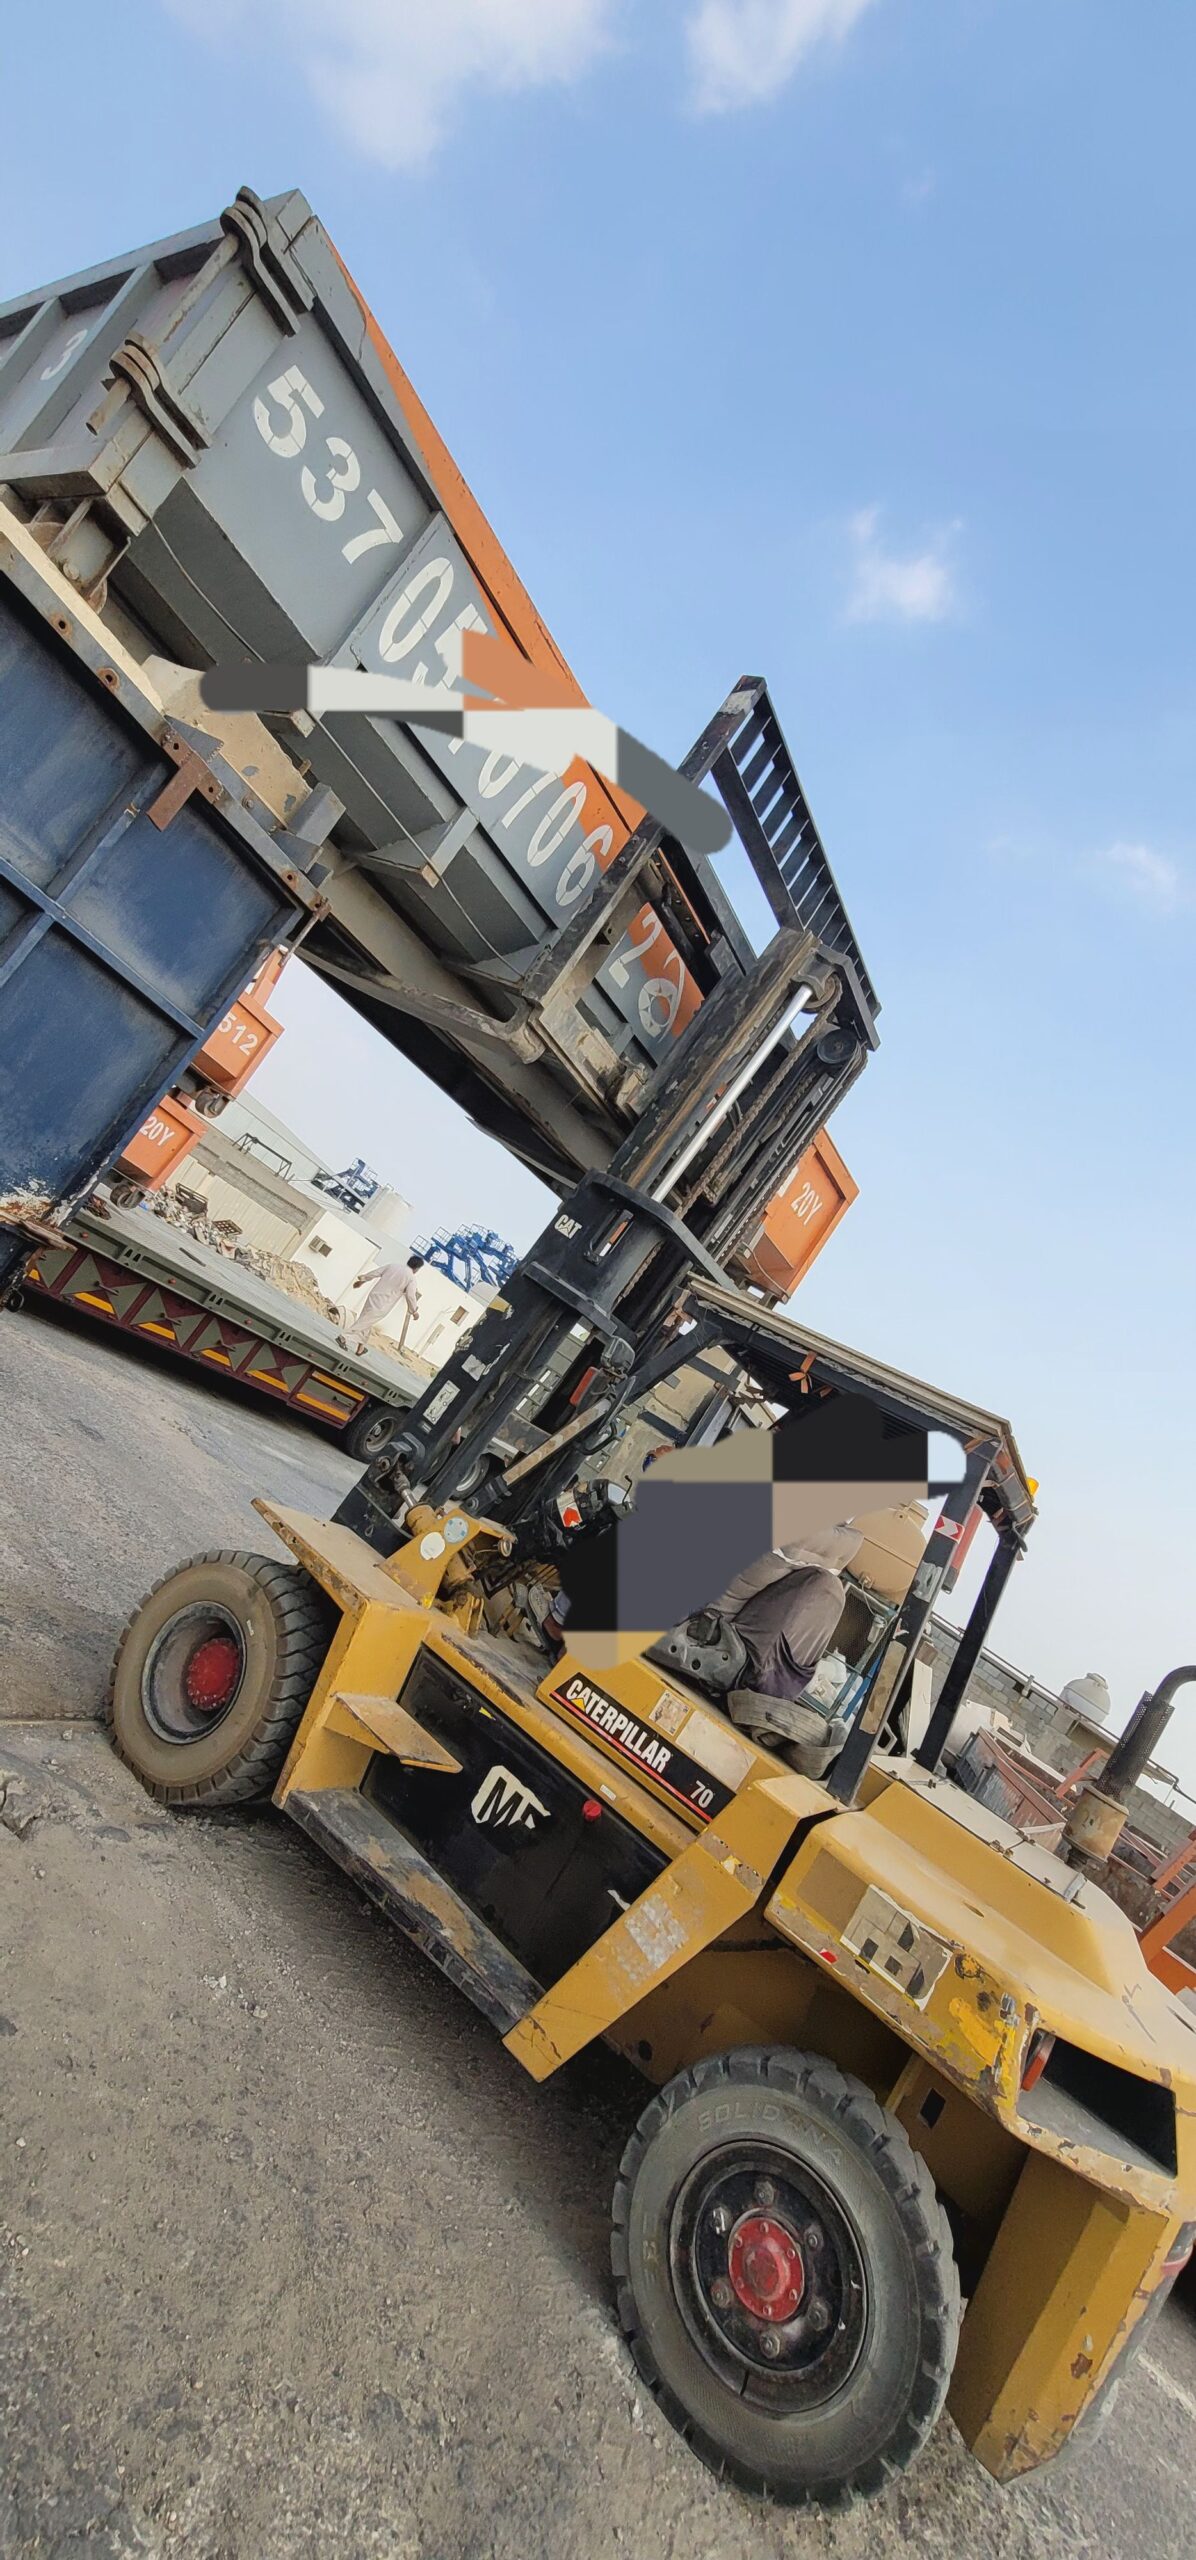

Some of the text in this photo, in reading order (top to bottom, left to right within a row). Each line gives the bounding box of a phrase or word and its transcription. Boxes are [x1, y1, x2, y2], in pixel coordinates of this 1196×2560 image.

[254, 365, 404, 564] 537
[140, 1116, 175, 1146] 20Y
[791, 1182, 823, 1226] 20Y
[554, 1214, 583, 1239] CAT
[566, 1679, 672, 1774] CATERPILLAR
[690, 1780, 714, 1809] 70
